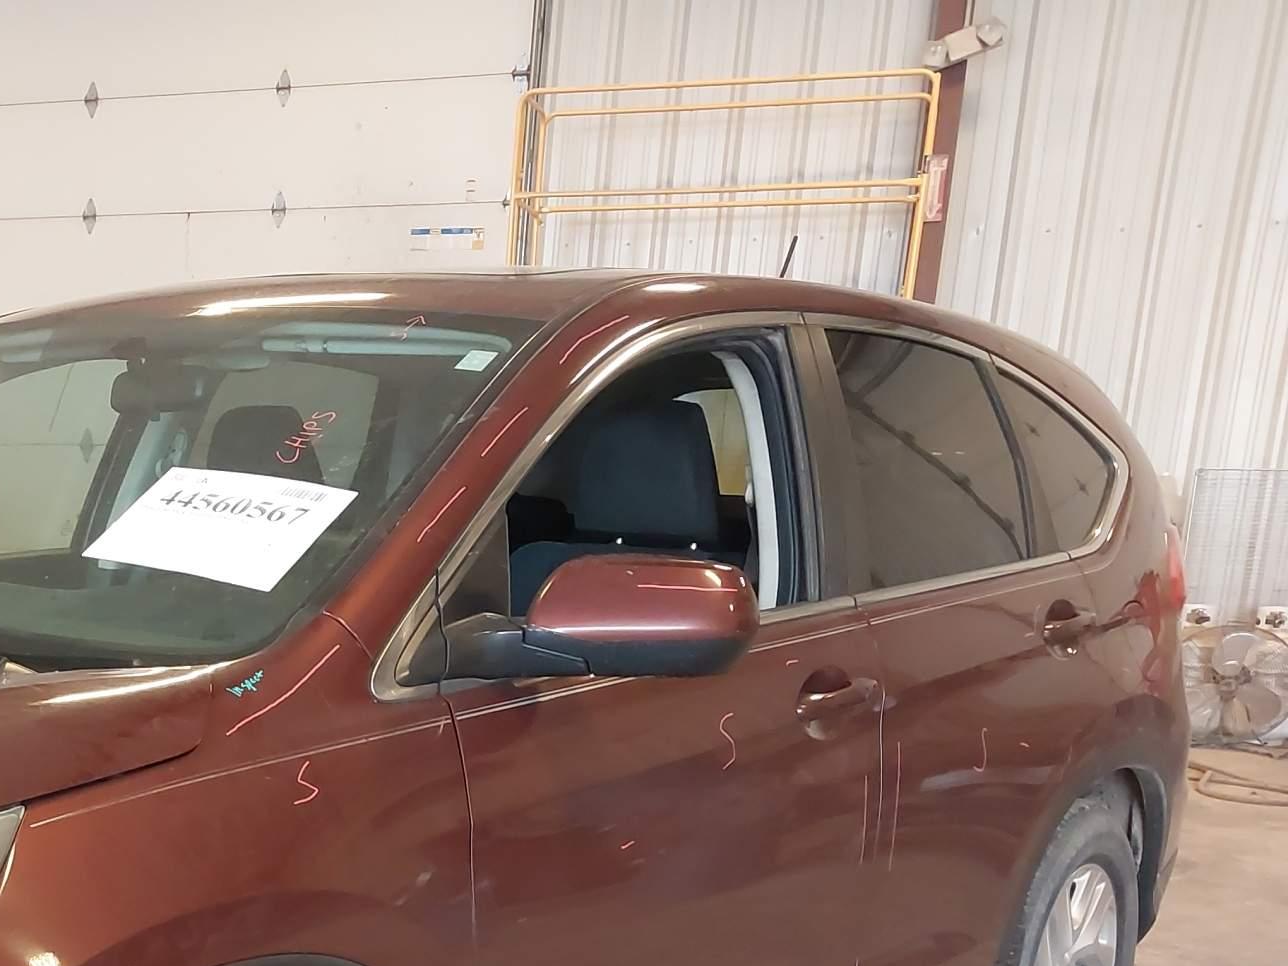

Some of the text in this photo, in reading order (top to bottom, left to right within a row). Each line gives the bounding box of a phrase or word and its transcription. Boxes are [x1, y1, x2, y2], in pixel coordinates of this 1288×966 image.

[276, 410, 336, 463] CHIPS
[159, 489, 311, 525] 44560567
[292, 760, 320, 806] S
